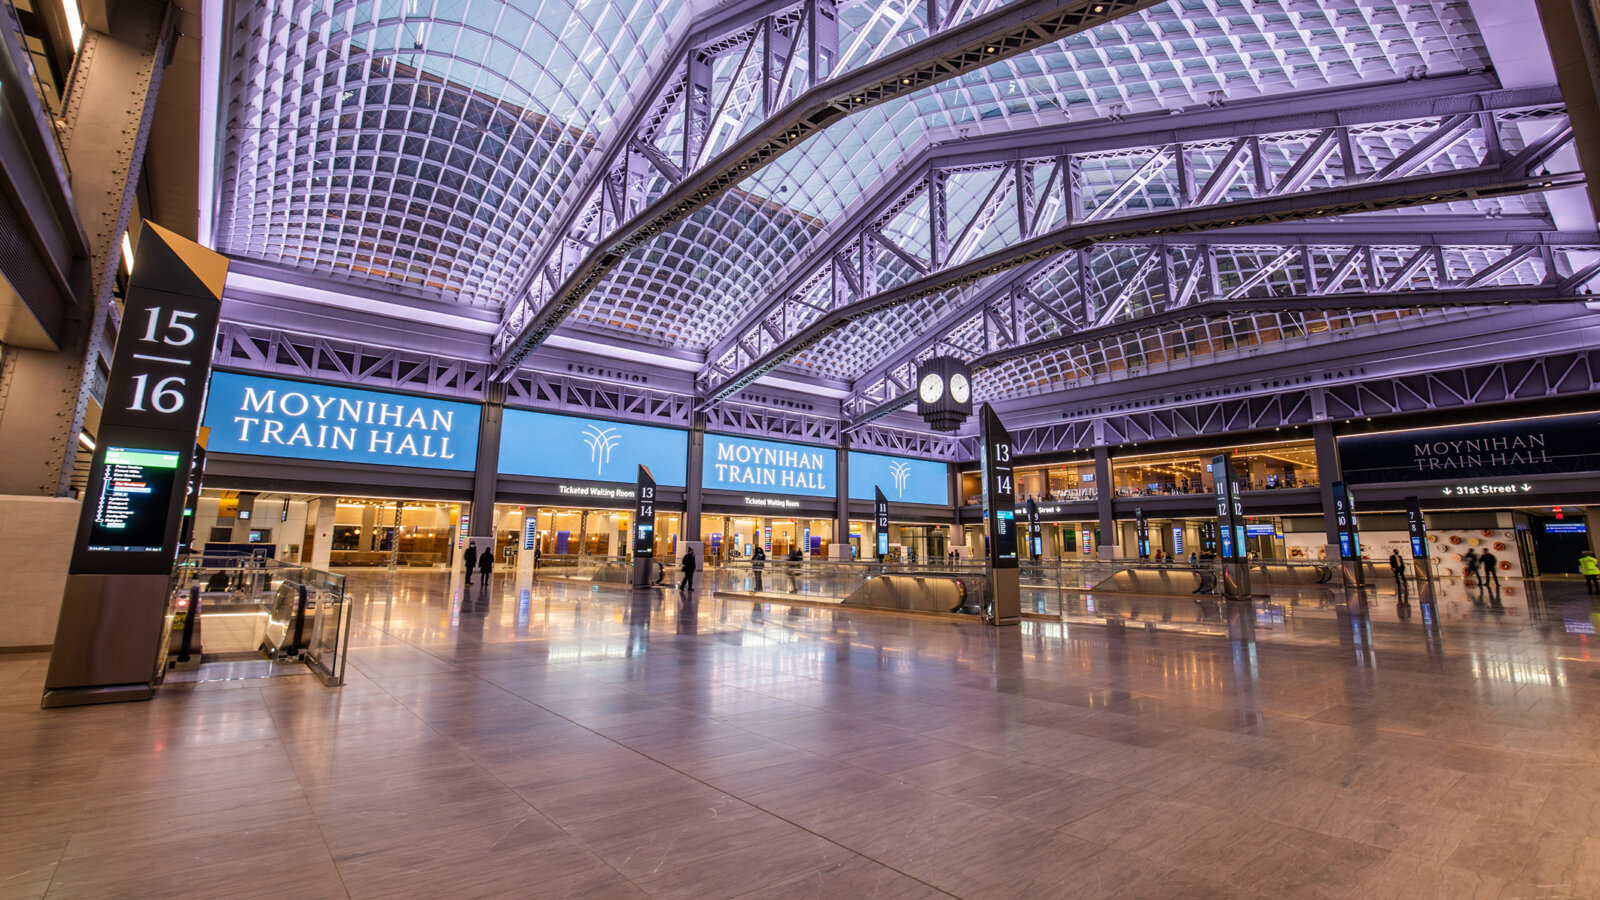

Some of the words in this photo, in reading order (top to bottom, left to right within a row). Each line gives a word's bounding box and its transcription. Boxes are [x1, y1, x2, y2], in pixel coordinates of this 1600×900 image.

[138, 306, 198, 347] 15
[567, 363, 648, 383] EXCELSIOR
[125, 373, 187, 414] 16
[1062, 407, 1102, 419] DANIEL
[1110, 398, 1166, 412] PATRICK
[1174, 384, 1252, 402] MOYNIHAN
[1261, 375, 1312, 389] TRAIN
[1323, 367, 1367, 380] HALL
[741, 393, 767, 403] EVER
[773, 398, 814, 411] UPWARD
[240, 387, 454, 432] MOYNIHAN
[234, 416, 358, 450] TRAIN
[368, 430, 455, 459] HALL
[1414, 433, 1546, 457] MOYNIHAN
[717, 443, 824, 471] MOYNIHAN
[995, 443, 1010, 462] 13
[1414, 454, 1482, 471] TRAIN
[1491, 450, 1553, 467] HALL
[715, 463, 776, 486] TRAIN
[781, 470, 826, 490] HALL
[559, 485, 589, 495] Ticketed
[590, 487, 615, 498] Waiting
[616, 489, 635, 498] Room
[996, 475, 1012, 495] 14
[1216, 482, 1224, 495] 11
[1232, 481, 1240, 495] 11
[1456, 486, 1480, 495] 31st
[1482, 484, 1517, 494] Street
[642, 487, 654, 498] 13
[745, 497, 767, 506] Ticketed
[767, 498, 785, 508] Waiting
[879, 503, 887, 512] 11
[1218, 503, 1227, 515] 12
[1234, 502, 1242, 515] 12
[1337, 500, 1343, 510] 9
[640, 505, 653, 517] 14
[1034, 513, 1039, 521] 9
[1409, 511, 1414, 520] 7
[879, 517, 888, 527] 12
[1338, 515, 1346, 526] 10
[1411, 523, 1417, 532] 8
